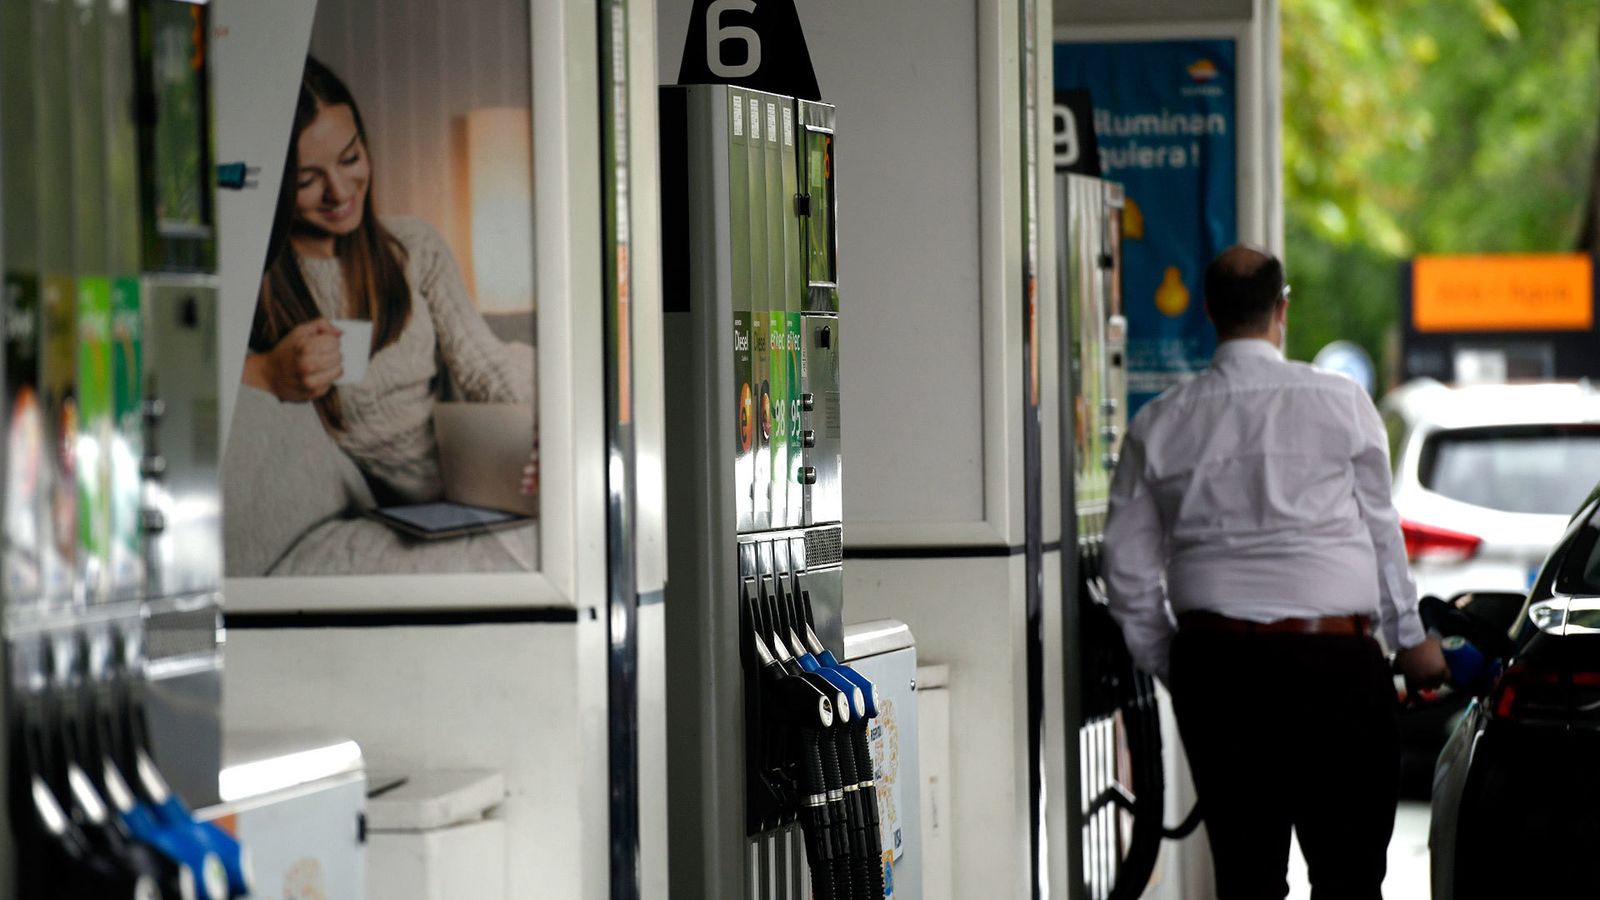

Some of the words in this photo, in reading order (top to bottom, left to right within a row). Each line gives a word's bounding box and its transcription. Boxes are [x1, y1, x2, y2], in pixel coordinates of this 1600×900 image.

[706, 0, 761, 77] 6
[1053, 104, 1079, 166] 9
[735, 330, 748, 350] Diesel
[775, 400, 785, 437] 98
[791, 400, 800, 437] 95
